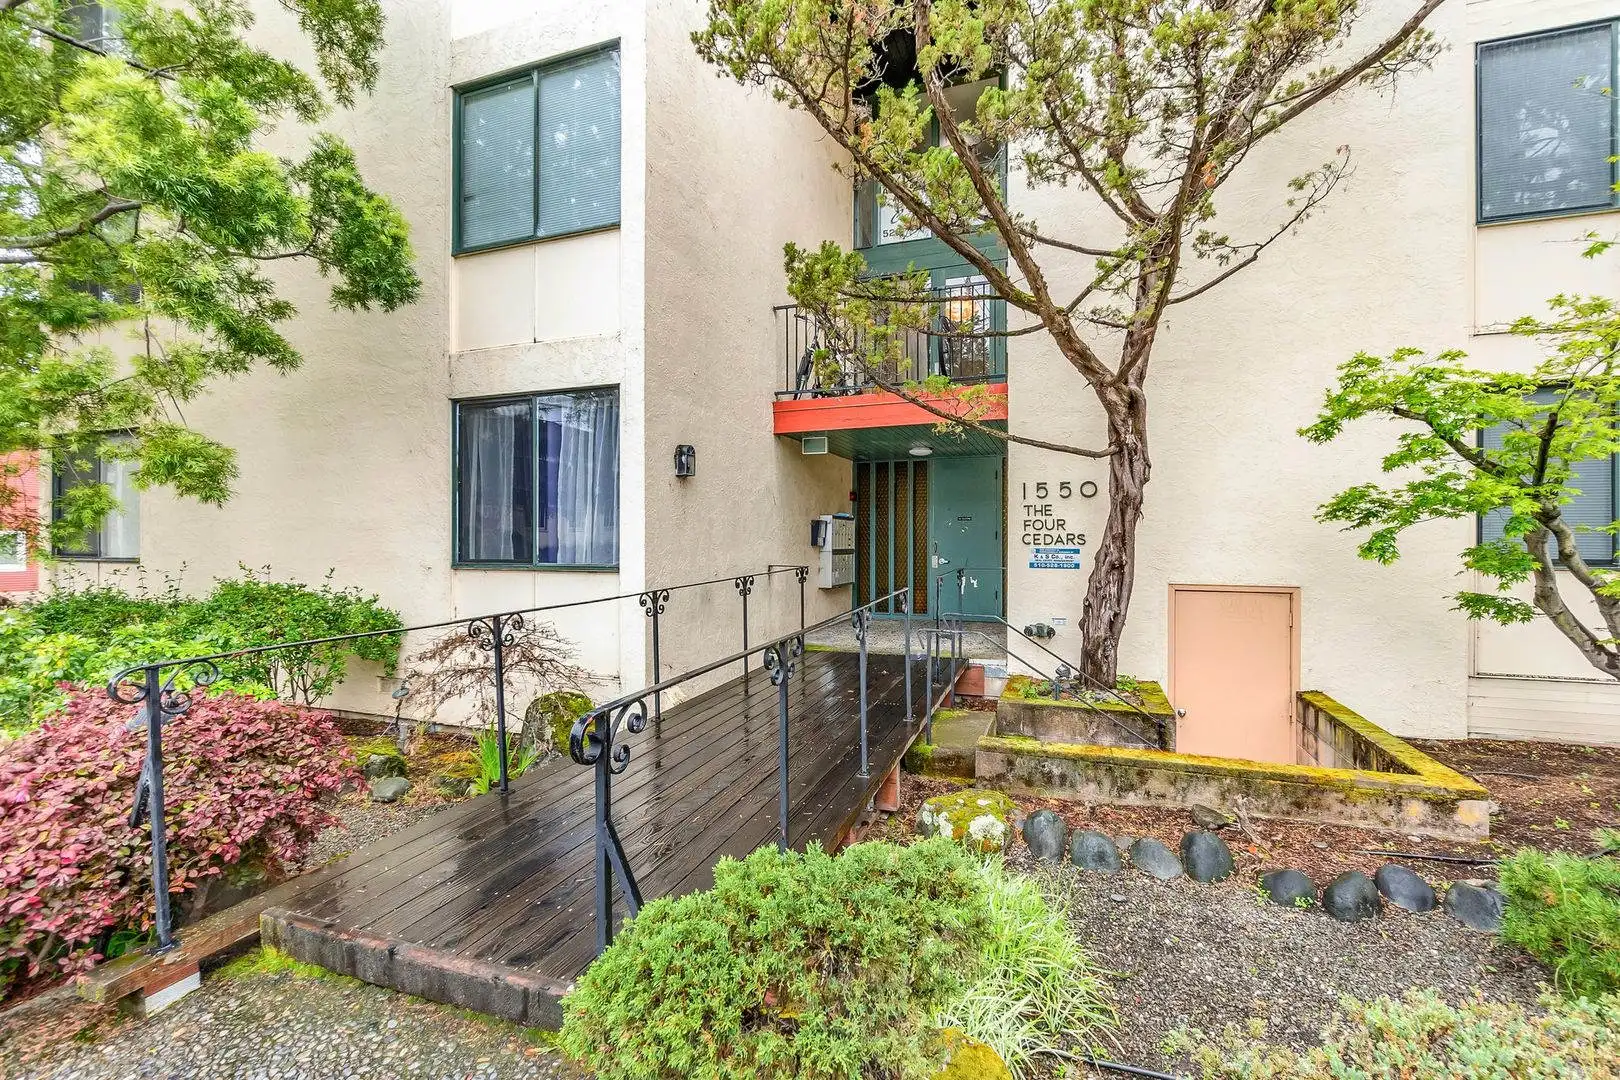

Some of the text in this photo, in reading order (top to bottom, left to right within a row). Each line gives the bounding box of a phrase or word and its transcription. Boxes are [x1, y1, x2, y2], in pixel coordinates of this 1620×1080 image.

[1023, 481, 1098, 500] 1550
[1023, 504, 1053, 516] THE
[1023, 519, 1066, 531] FOUR
[1022, 533, 1086, 545] CEDARS
